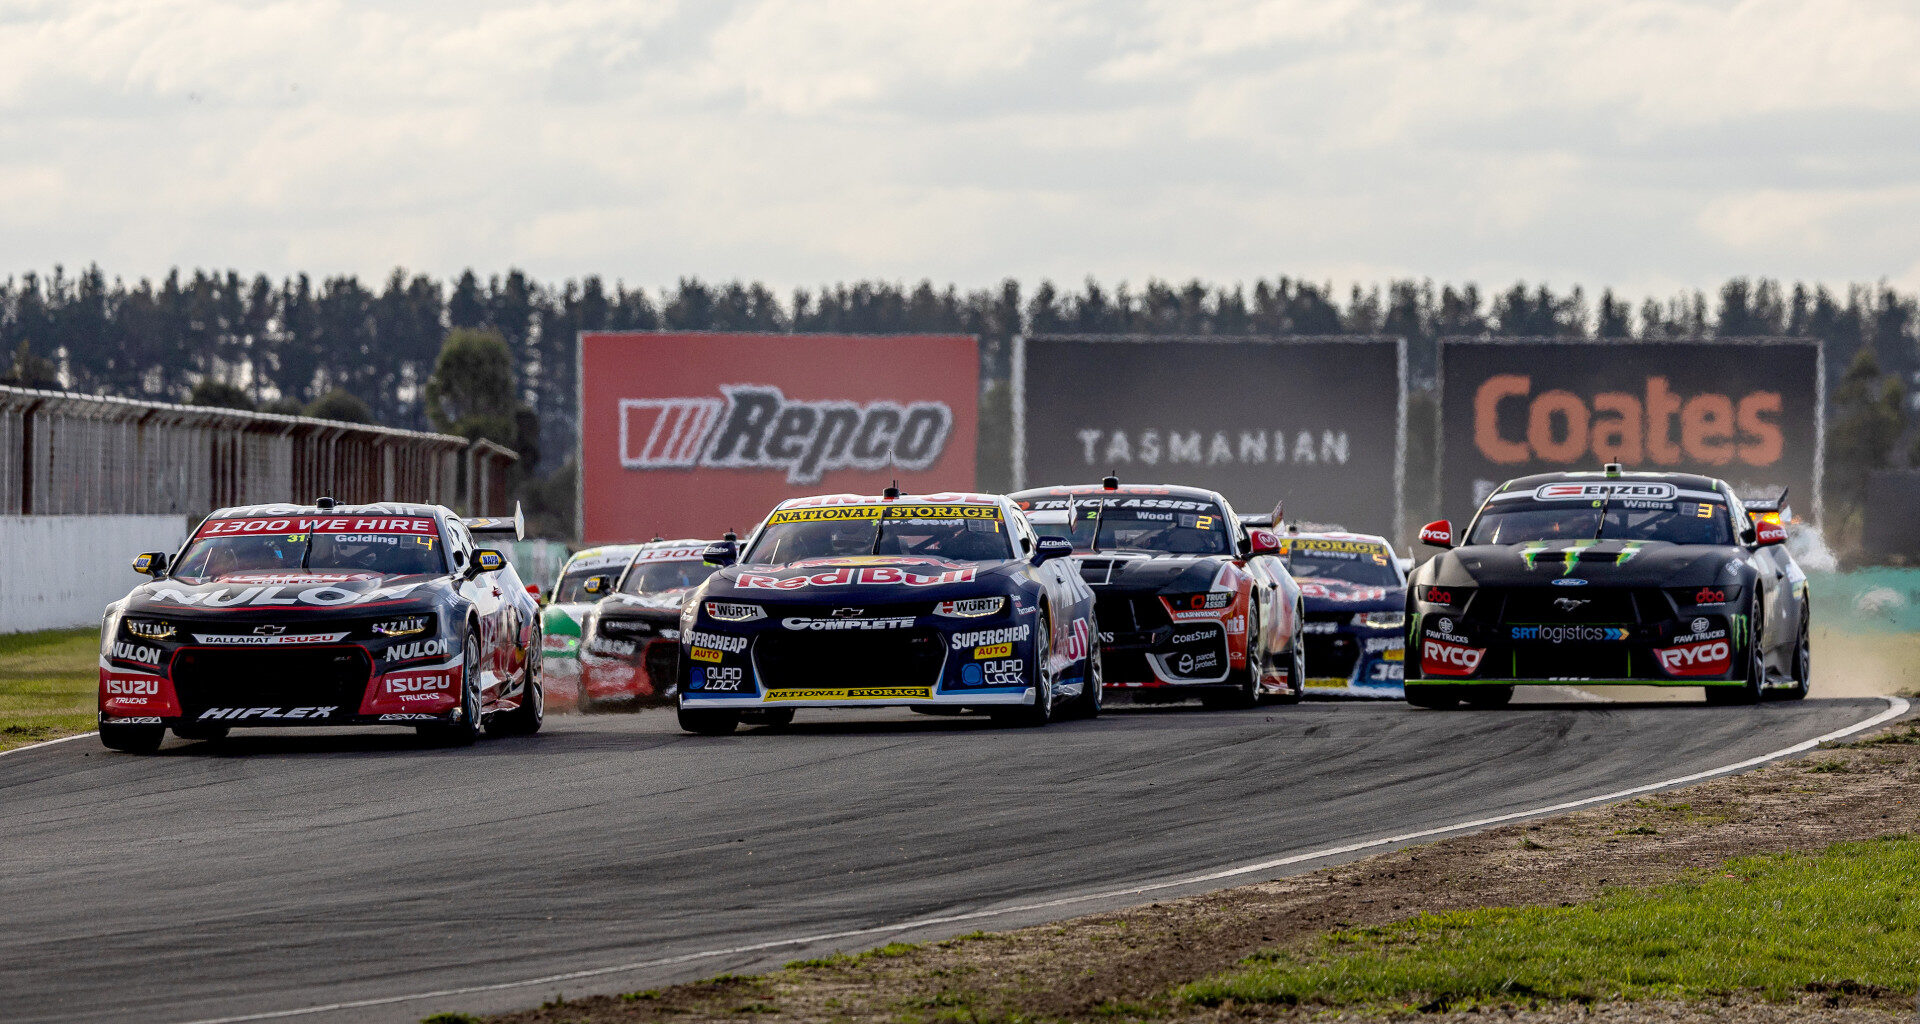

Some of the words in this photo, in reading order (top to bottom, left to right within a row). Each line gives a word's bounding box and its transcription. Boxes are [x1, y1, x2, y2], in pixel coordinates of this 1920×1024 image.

[1475, 375, 1783, 466] Coates
[703, 385, 951, 483] Repco
[1080, 429, 1350, 464] TASMANIAN
[1585, 486, 1663, 495] ENZED
[1034, 499, 1120, 510] TRUCK
[1122, 500, 1213, 511] ASSIST
[1592, 500, 1601, 508] 6
[1624, 500, 1674, 509] Waters
[1697, 503, 1713, 518] 3
[774, 507, 880, 523] NATIONAL
[891, 506, 994, 518] STORAGE
[1137, 511, 1173, 520] Wood
[205, 519, 292, 534] 1300
[300, 519, 350, 531] WE
[354, 519, 431, 532] HIRE
[1196, 515, 1213, 530] 2
[287, 534, 305, 543] 31
[334, 534, 398, 545] Golding
[1422, 529, 1450, 540] RYCO
[416, 536, 433, 551] 4
[481, 555, 500, 566] NAPA
[735, 569, 855, 591] Red
[857, 567, 978, 588] Bull
[149, 586, 420, 608] NULON
[1206, 593, 1227, 602] TRUCK
[1204, 601, 1227, 609] ASSIST
[132, 621, 177, 636] SYZMIK
[371, 618, 424, 634] SYZMIK
[782, 617, 916, 631] COMPLETE
[205, 636, 272, 644] BALLARAT
[279, 635, 334, 643] ISUZU
[681, 627, 748, 654] SUPERCHEAP
[951, 623, 1030, 650] SUPERCHEAP
[111, 641, 162, 665] NULON
[385, 637, 448, 662] NULON
[693, 649, 720, 660] AUTO
[977, 646, 1009, 657] AUTO
[1423, 640, 1480, 668] RYCO
[1660, 641, 1729, 668] RYCO
[706, 666, 742, 680] QUAD
[983, 658, 1024, 675] QUAD
[385, 674, 451, 694] ISUZU
[704, 679, 742, 691] LOCK
[984, 672, 1025, 684] LOCK
[106, 679, 159, 696] ISUZU
[767, 689, 845, 699] NATIONAL
[852, 688, 926, 697] STORAGE
[115, 697, 148, 705] TRUCKS
[399, 692, 441, 702] TRUCKS
[199, 705, 339, 719] HIFLEX
